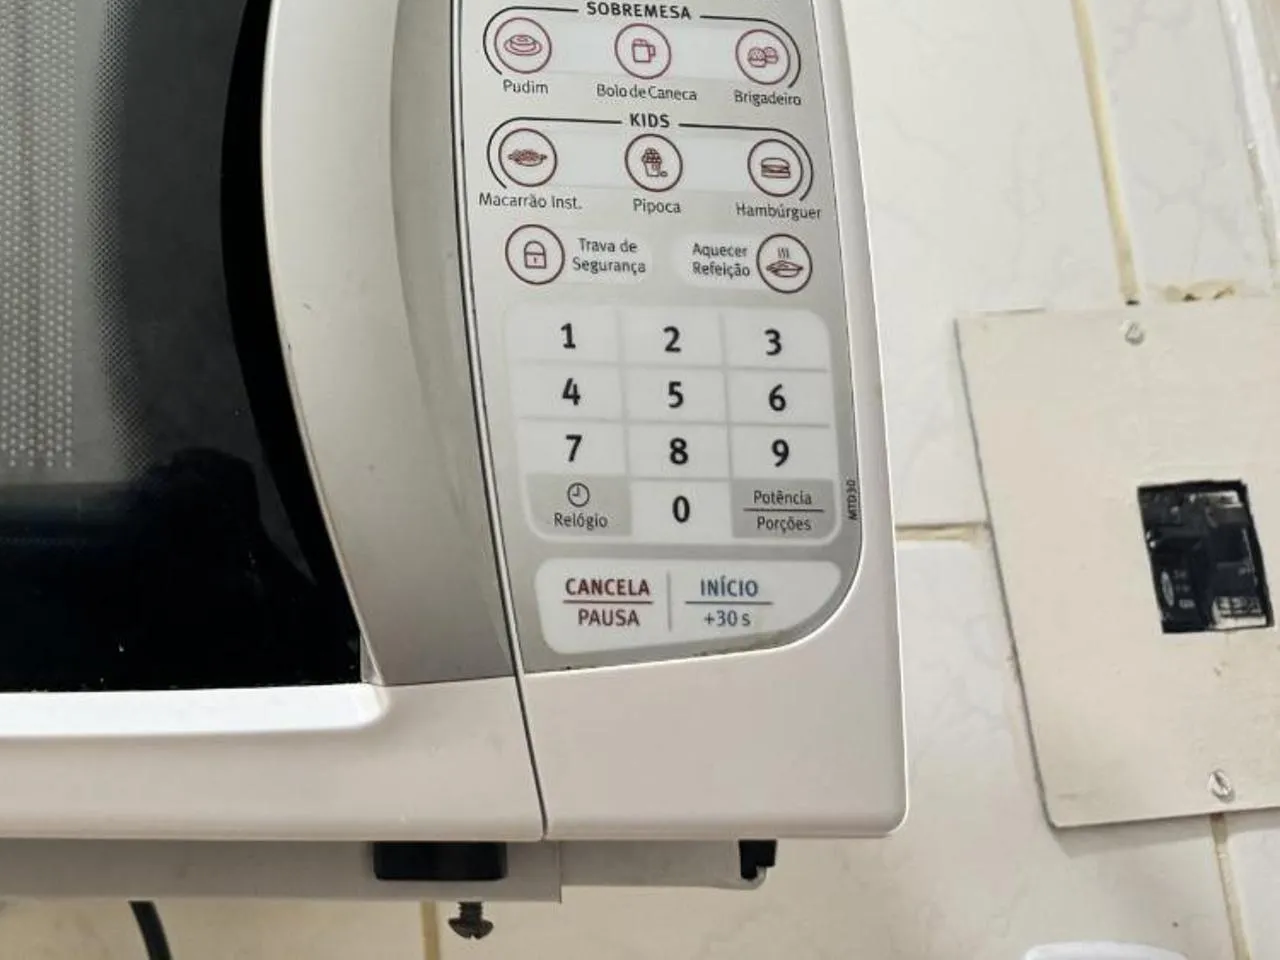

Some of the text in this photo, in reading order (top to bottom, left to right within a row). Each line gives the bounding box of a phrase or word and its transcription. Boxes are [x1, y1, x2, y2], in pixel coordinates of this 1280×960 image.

[586, 2, 691, 19] SOBREMESA
[503, 80, 548, 94] Pudim
[597, 84, 697, 101] Bolo de Caneca
[734, 90, 801, 107] Brigadeiro
[630, 114, 670, 128] KIDS
[479, 193, 582, 210] Macarrão Inst.
[633, 199, 681, 216] Pipoca
[736, 204, 821, 220] Hambúrguer
[579, 238, 638, 253] Trava de
[693, 243, 747, 259] Aquecer
[573, 257, 646, 275] Segurança
[693, 261, 750, 278] Refeição
[561, 323, 576, 349] 1
[664, 326, 681, 353] 2
[765, 329, 782, 355] 3
[562, 378, 580, 405] 4
[668, 381, 683, 408] 5
[768, 384, 786, 411] 6
[565, 435, 582, 462] 7
[670, 438, 688, 465] 8
[772, 439, 789, 467] 9
[754, 490, 811, 506] Potência
[672, 496, 689, 523] 0
[554, 513, 607, 529] Relógio
[757, 516, 811, 532] Porções
[565, 579, 650, 597] CANCELA
[700, 577, 758, 597] INÍCIO
[578, 609, 640, 626] PAUSA
[705, 611, 751, 626] +30 s
